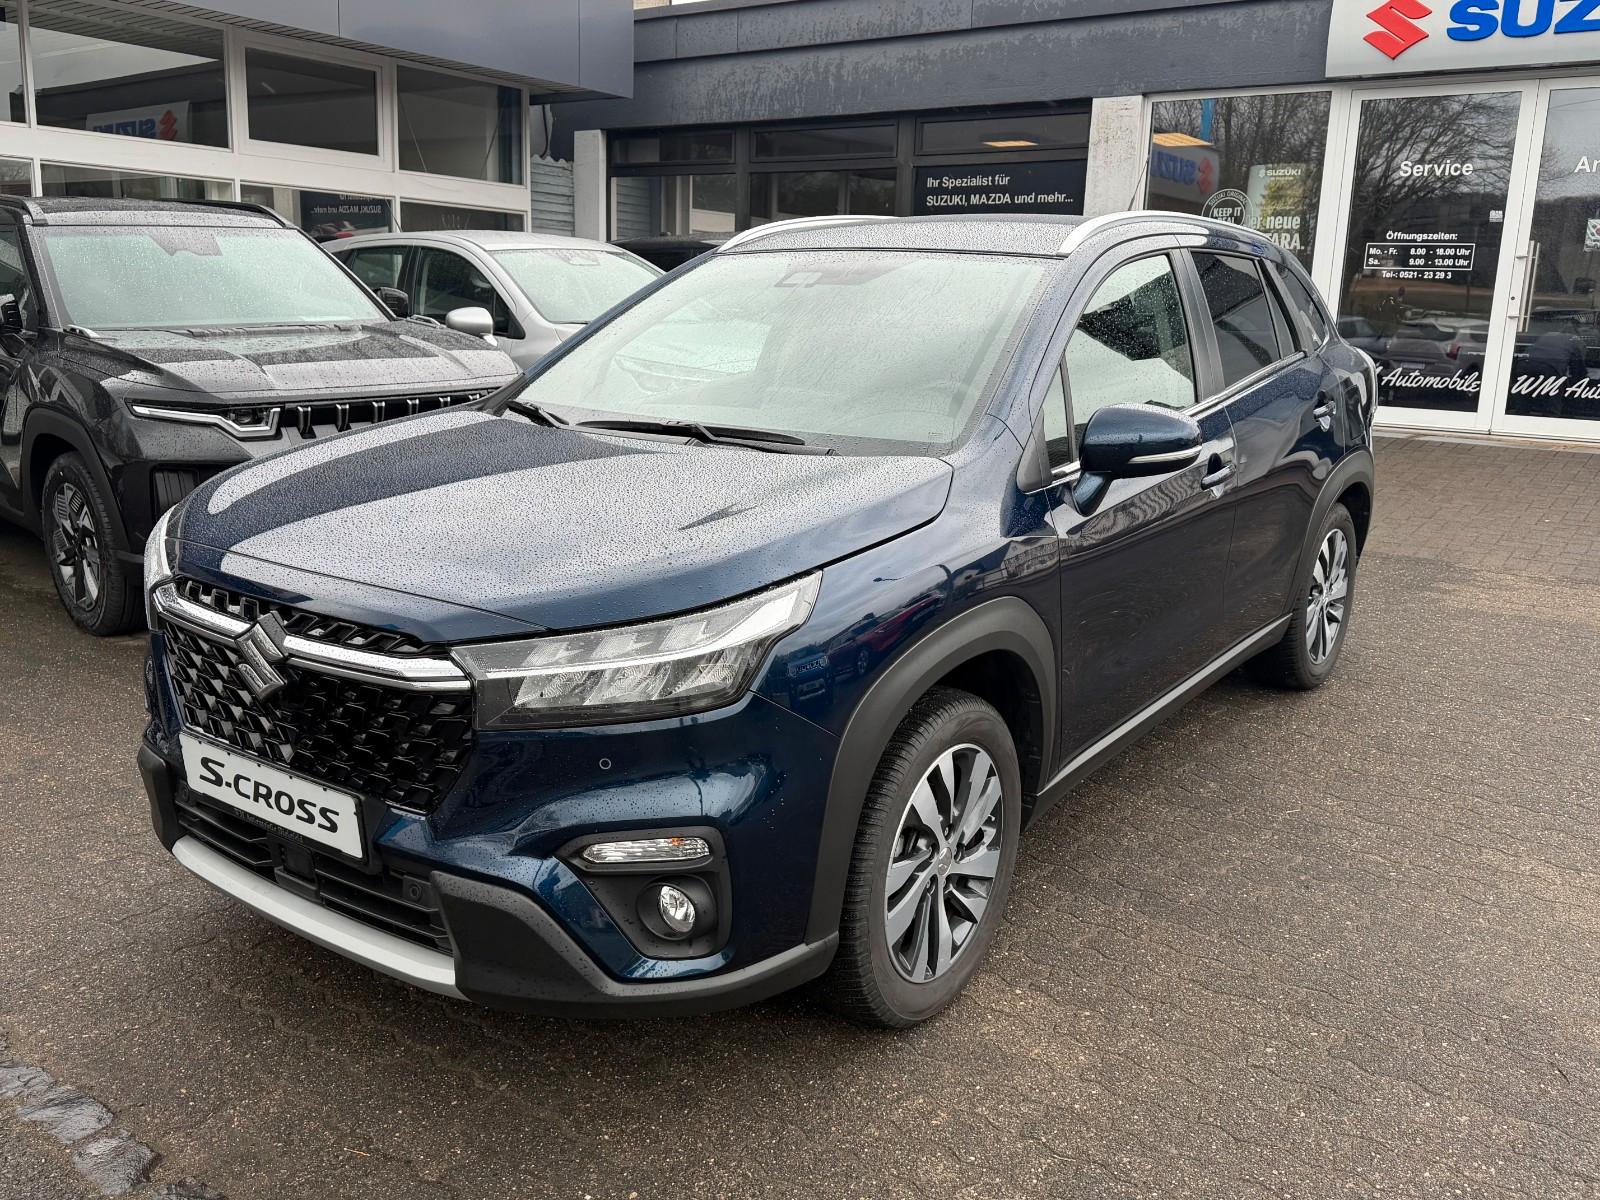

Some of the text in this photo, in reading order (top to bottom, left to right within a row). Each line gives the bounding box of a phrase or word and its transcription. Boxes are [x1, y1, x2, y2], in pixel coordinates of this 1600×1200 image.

[1400, 160, 1473, 177] Service
[927, 174, 1011, 189] Ihr Spezialist für
[926, 192, 1073, 207] SUZUKI, MAZDA und mehr...
[1213, 207, 1242, 217] KEEP IT
[1266, 216, 1301, 229] neue
[1386, 231, 1458, 241] Öffnungszeiten:
[1369, 247, 1383, 255] Mo.
[1389, 247, 1398, 255] Fr.
[1456, 248, 1471, 256] Uhr
[1409, 258, 1425, 266] 9.00
[1434, 258, 1454, 266] 13.00
[1455, 258, 1470, 266] Uhr
[1399, 271, 1417, 279] 0521
[1423, 271, 1433, 279] 23
[1435, 271, 1445, 279] 29
[1446, 271, 1452, 279] 3
[1381, 367, 1481, 393] Automobile
[1511, 375, 1567, 398] WM
[200, 757, 339, 834] S.CROSS
